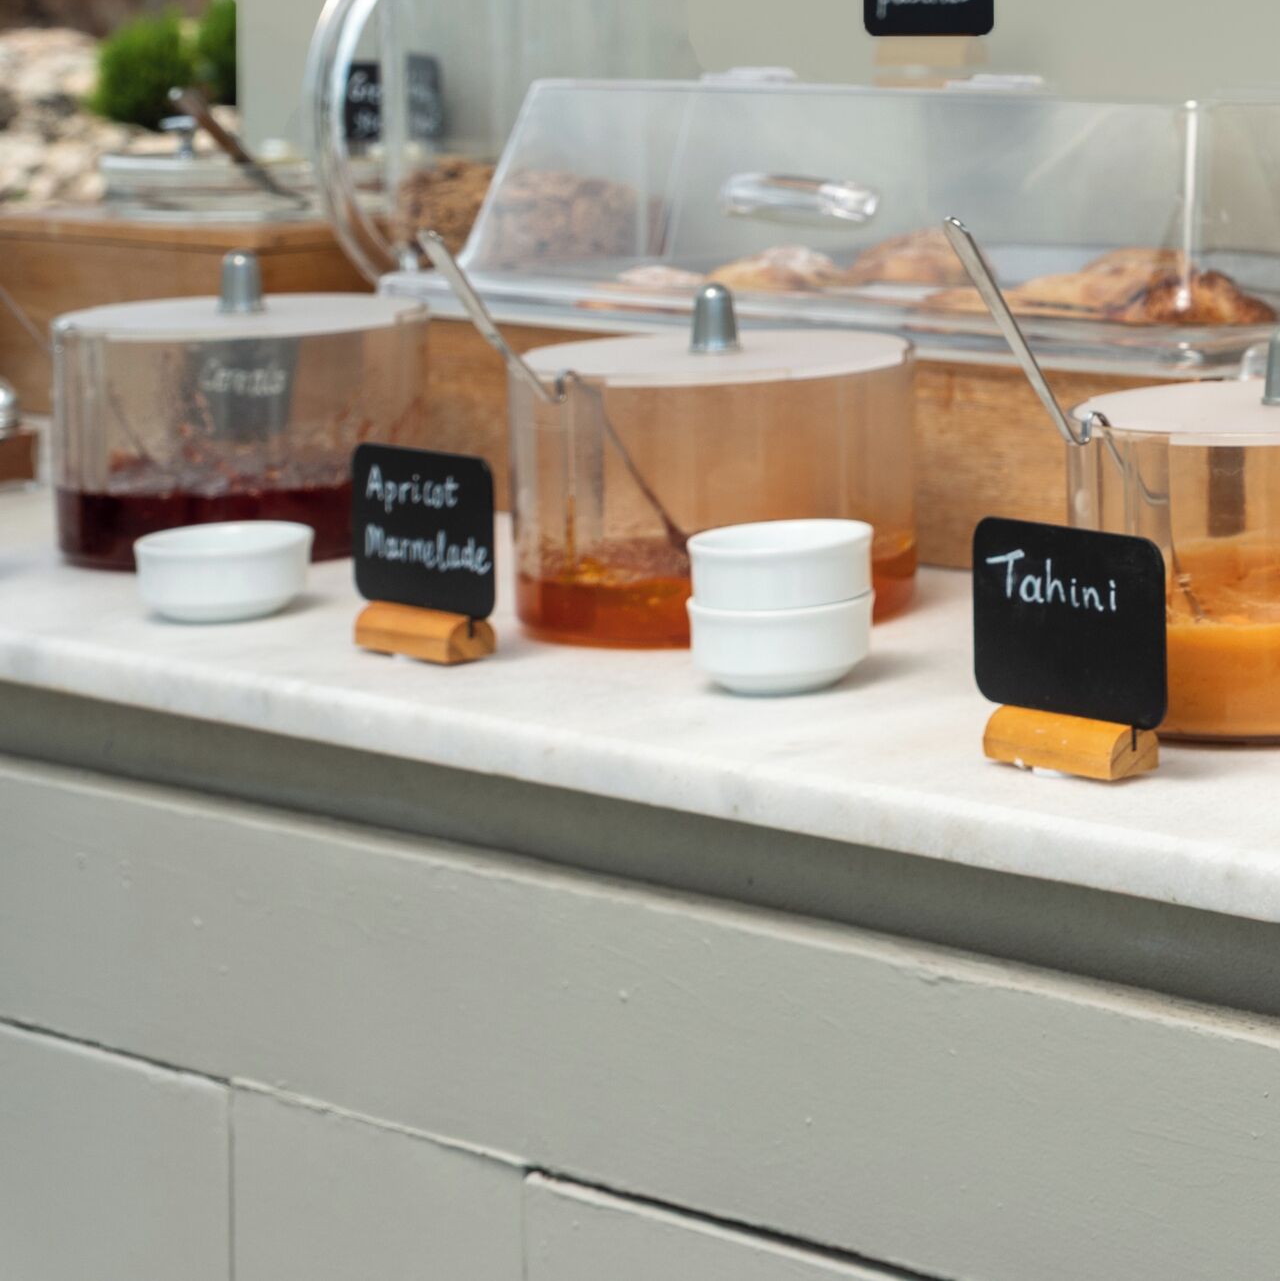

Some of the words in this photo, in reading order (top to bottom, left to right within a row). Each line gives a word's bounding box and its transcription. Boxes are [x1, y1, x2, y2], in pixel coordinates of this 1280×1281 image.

[365, 463, 460, 514] Apricot
[364, 522, 492, 576] Marmelade
[985, 548, 1117, 612] Tahini
